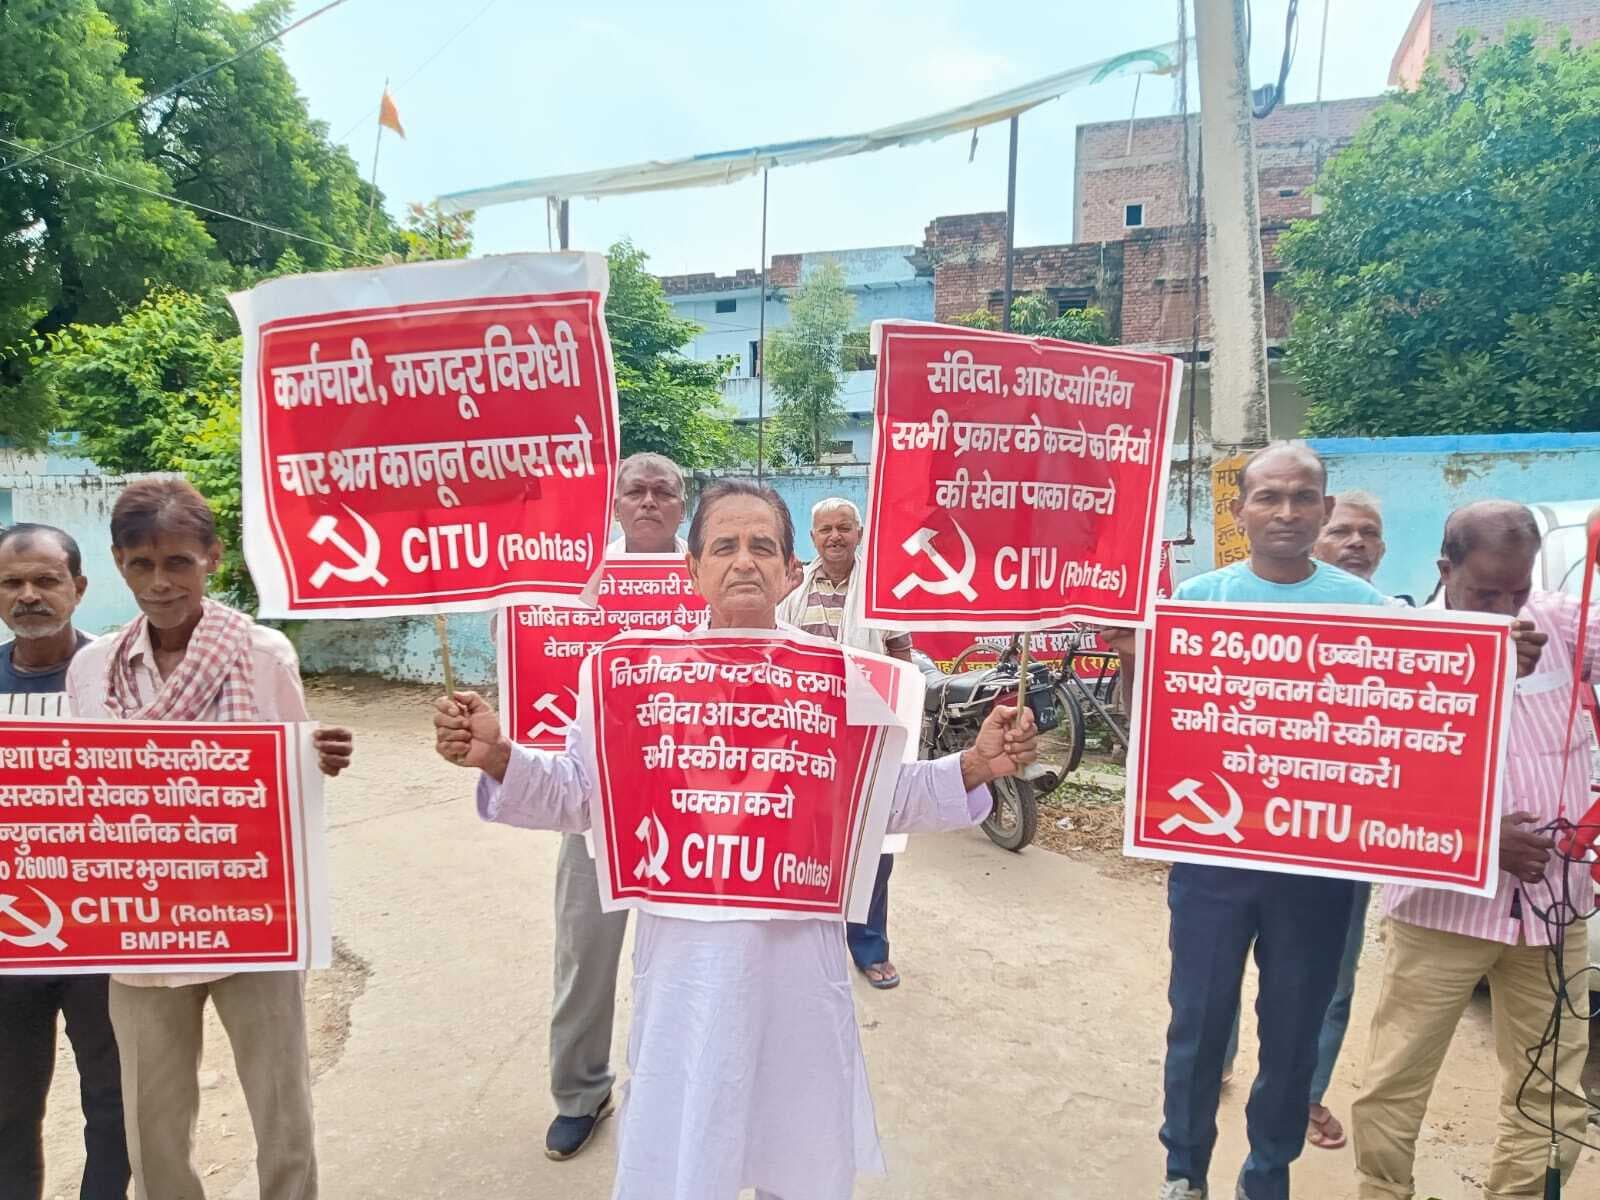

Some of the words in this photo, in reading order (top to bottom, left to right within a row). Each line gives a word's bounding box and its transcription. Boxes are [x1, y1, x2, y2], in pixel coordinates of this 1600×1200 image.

[271, 337, 388, 411] कर्मचारी,
[386, 347, 485, 419] मजदूर
[484, 320, 580, 391] विरोधी
[927, 350, 1008, 398] संविदा,
[892, 409, 950, 450] सभी
[952, 421, 1014, 458] प्रकार
[1014, 413, 1042, 453] के
[277, 450, 329, 497] चार
[328, 446, 378, 493] श्रम
[376, 439, 469, 508] कानून
[466, 433, 553, 481] वापस
[549, 415, 595, 479] लो
[935, 467, 971, 509] की
[970, 469, 1018, 510] सेवा
[1071, 478, 1116, 515] करो
[401, 522, 490, 575] CITU
[497, 532, 594, 572] (Rohtas)
[617, 573, 681, 596] सरकारी
[993, 545, 1058, 591] CITU
[1060, 560, 1127, 598] (Rohtas)
[518, 605, 570, 627] घोषित
[572, 604, 606, 627] करो
[543, 636, 584, 658] वेतन
[1169, 627, 1202, 657] Rs
[1211, 629, 1302, 664] 26,000
[1307, 632, 1399, 673] (छब्बीस
[1398, 642, 1476, 685] हजार)
[610, 655, 719, 688] निजीकरण
[719, 662, 752, 684] पर
[636, 692, 702, 727] संविदा
[702, 699, 838, 739] आउटसोर्सिंग
[1317, 672, 1415, 712] वैधानिक
[1418, 681, 1478, 717] वेतन
[1171, 700, 1220, 734] सभी
[1221, 705, 1277, 739] वेतन
[1279, 709, 1331, 745] सभी
[1332, 713, 1402, 751] स्कीम
[1404, 722, 1466, 756] वर्कर
[37, 739, 71, 770] एवं
[74, 747, 133, 770] आशा
[134, 738, 250, 770] फैसलीटेटर
[676, 735, 749, 771] स्कीम
[751, 740, 811, 776] वर्कर
[810, 748, 838, 780] को
[1222, 744, 1257, 776] को
[1257, 751, 1346, 790] भुगतान
[0, 775, 85, 807] सरकारी
[87, 777, 150, 807] सेवक
[152, 776, 219, 807] घोषित
[222, 779, 268, 808] करो
[671, 788, 743, 815] पक्का
[744, 784, 796, 819] करो
[88, 814, 181, 844] वैधानिक
[184, 815, 238, 844] वेतन
[1263, 797, 1352, 843] CITU
[1359, 819, 1463, 863] (Rohtas)
[14, 855, 68, 880] 26000
[71, 858, 135, 882] हजार
[135, 858, 220, 890] भुगतान
[222, 852, 269, 880] करो
[681, 832, 765, 882] CITU
[773, 852, 832, 894] (Rohtas)
[70, 896, 161, 924] CITU
[170, 904, 274, 926] (Rohtas)
[120, 930, 230, 951] BMPHEA
